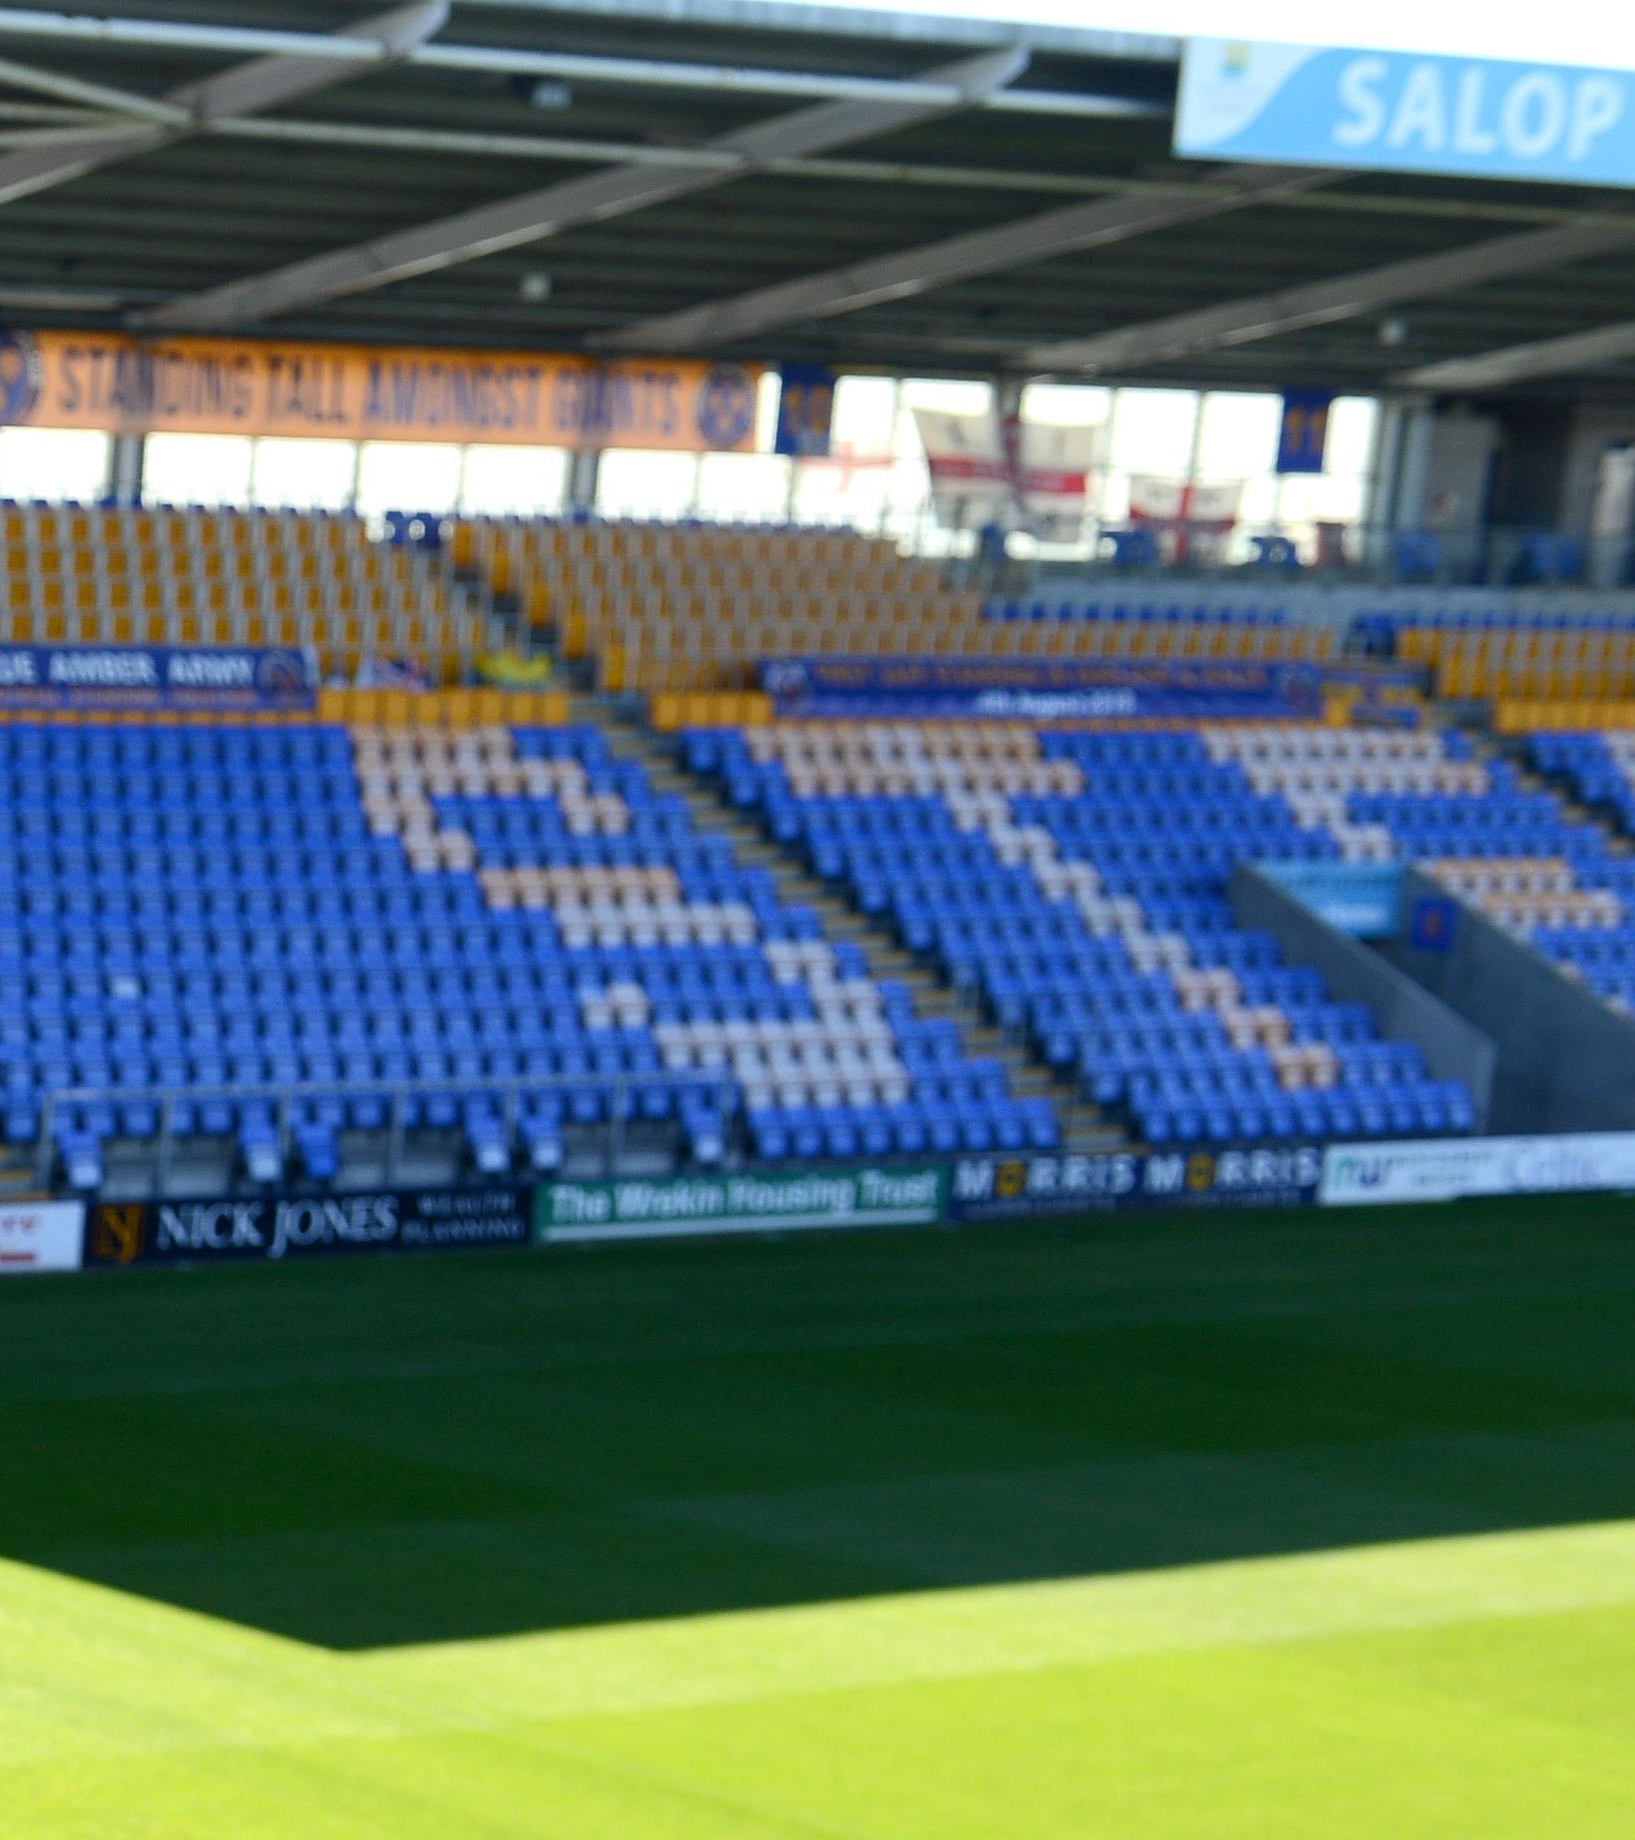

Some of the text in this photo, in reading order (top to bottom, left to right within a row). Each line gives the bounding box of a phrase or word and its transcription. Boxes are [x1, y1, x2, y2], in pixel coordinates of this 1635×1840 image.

[1335, 58, 1628, 161] SALOP
[49, 650, 159, 685] AMBER
[168, 653, 254, 686] ARMY
[954, 1155, 1137, 1199] MORRIS
[1144, 1148, 1320, 1194] MORRIS
[551, 1183, 610, 1222] The
[156, 1196, 399, 1258] NICK JONES
